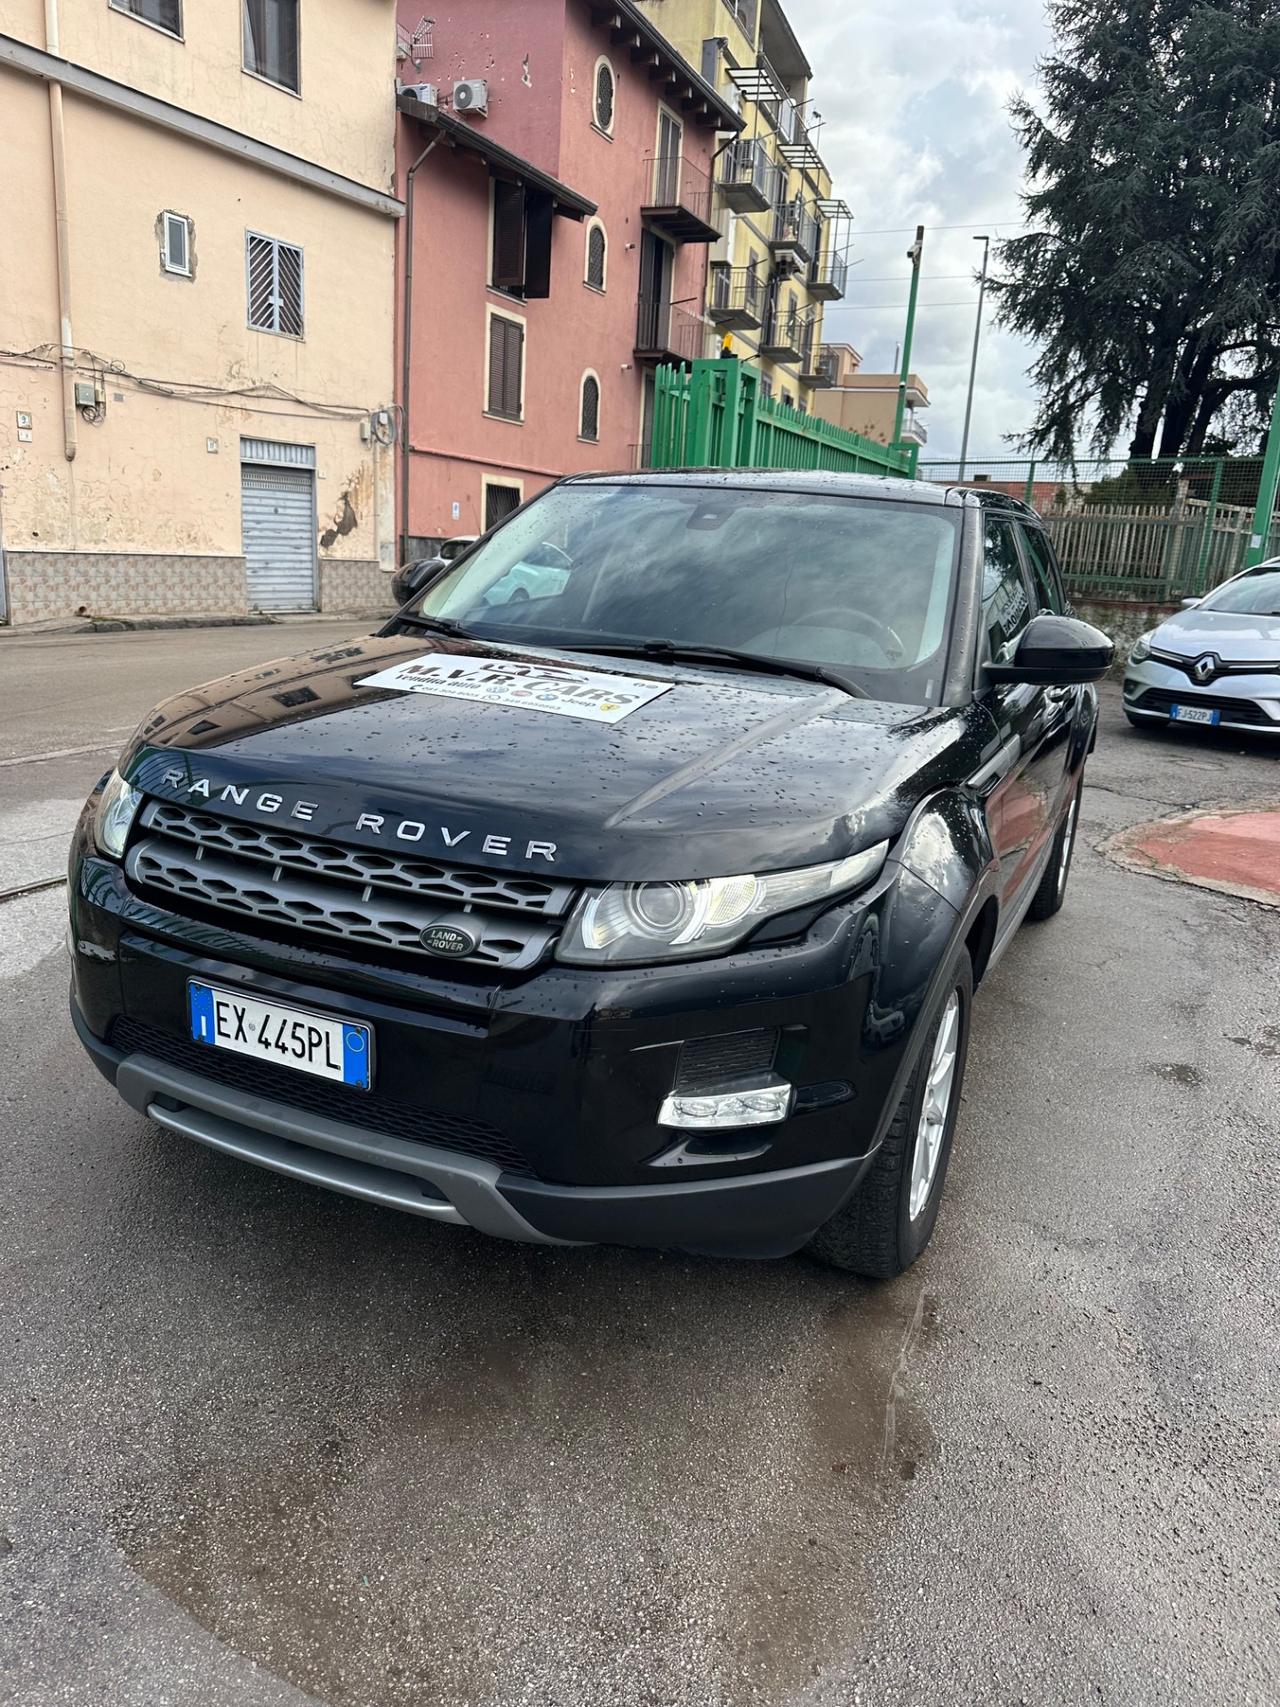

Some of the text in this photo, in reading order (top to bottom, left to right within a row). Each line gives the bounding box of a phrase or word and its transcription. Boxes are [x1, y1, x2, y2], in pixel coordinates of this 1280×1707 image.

[398, 664, 516, 687] M.V.R.
[523, 681, 640, 705] CARS
[160, 768, 320, 822] RANGE
[355, 812, 557, 862] ROVER
[431, 930, 457, 941] LAND
[431, 939, 464, 951] ROVER
[216, 1001, 248, 1043] EX
[257, 1014, 342, 1071] 445PL
